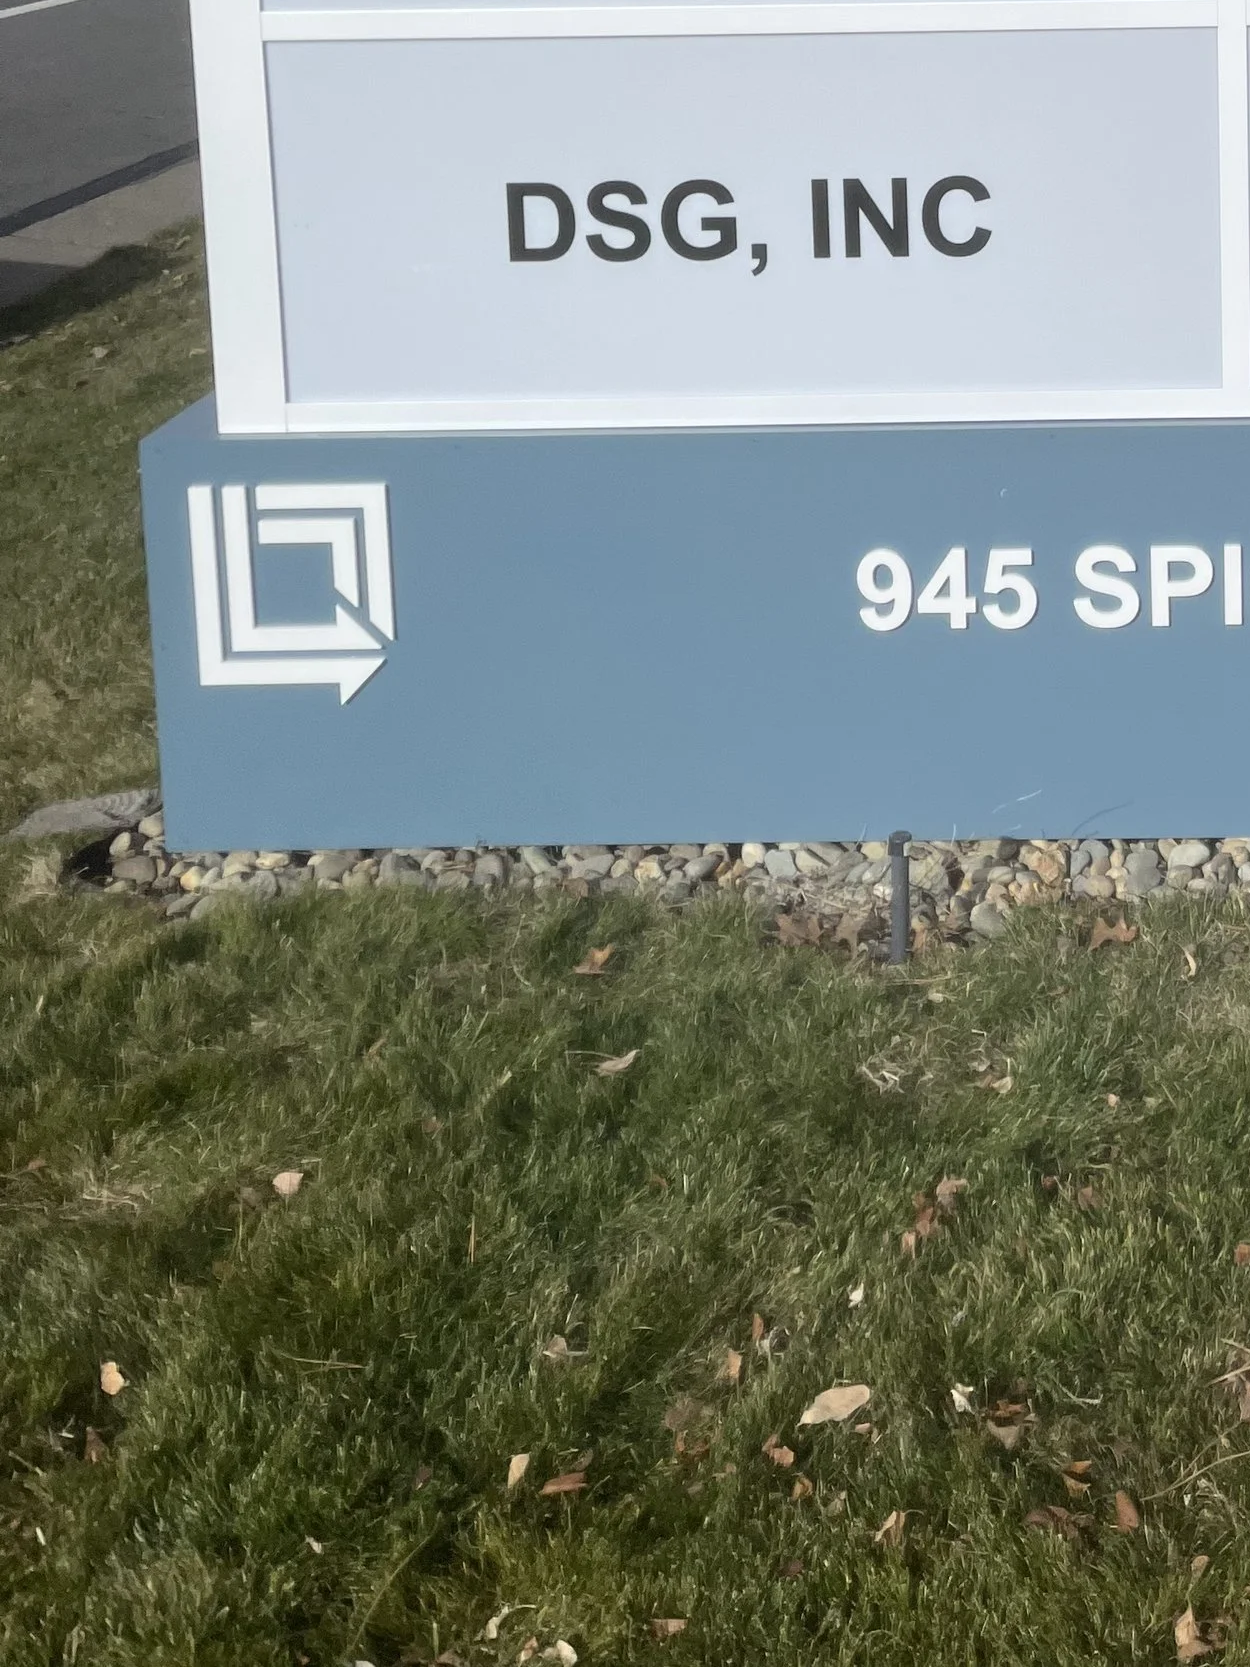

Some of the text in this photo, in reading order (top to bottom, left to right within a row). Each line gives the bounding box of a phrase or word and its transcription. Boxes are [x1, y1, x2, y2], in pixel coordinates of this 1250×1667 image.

[506, 175, 992, 276] DSG, INC
[856, 547, 1038, 632] 945
